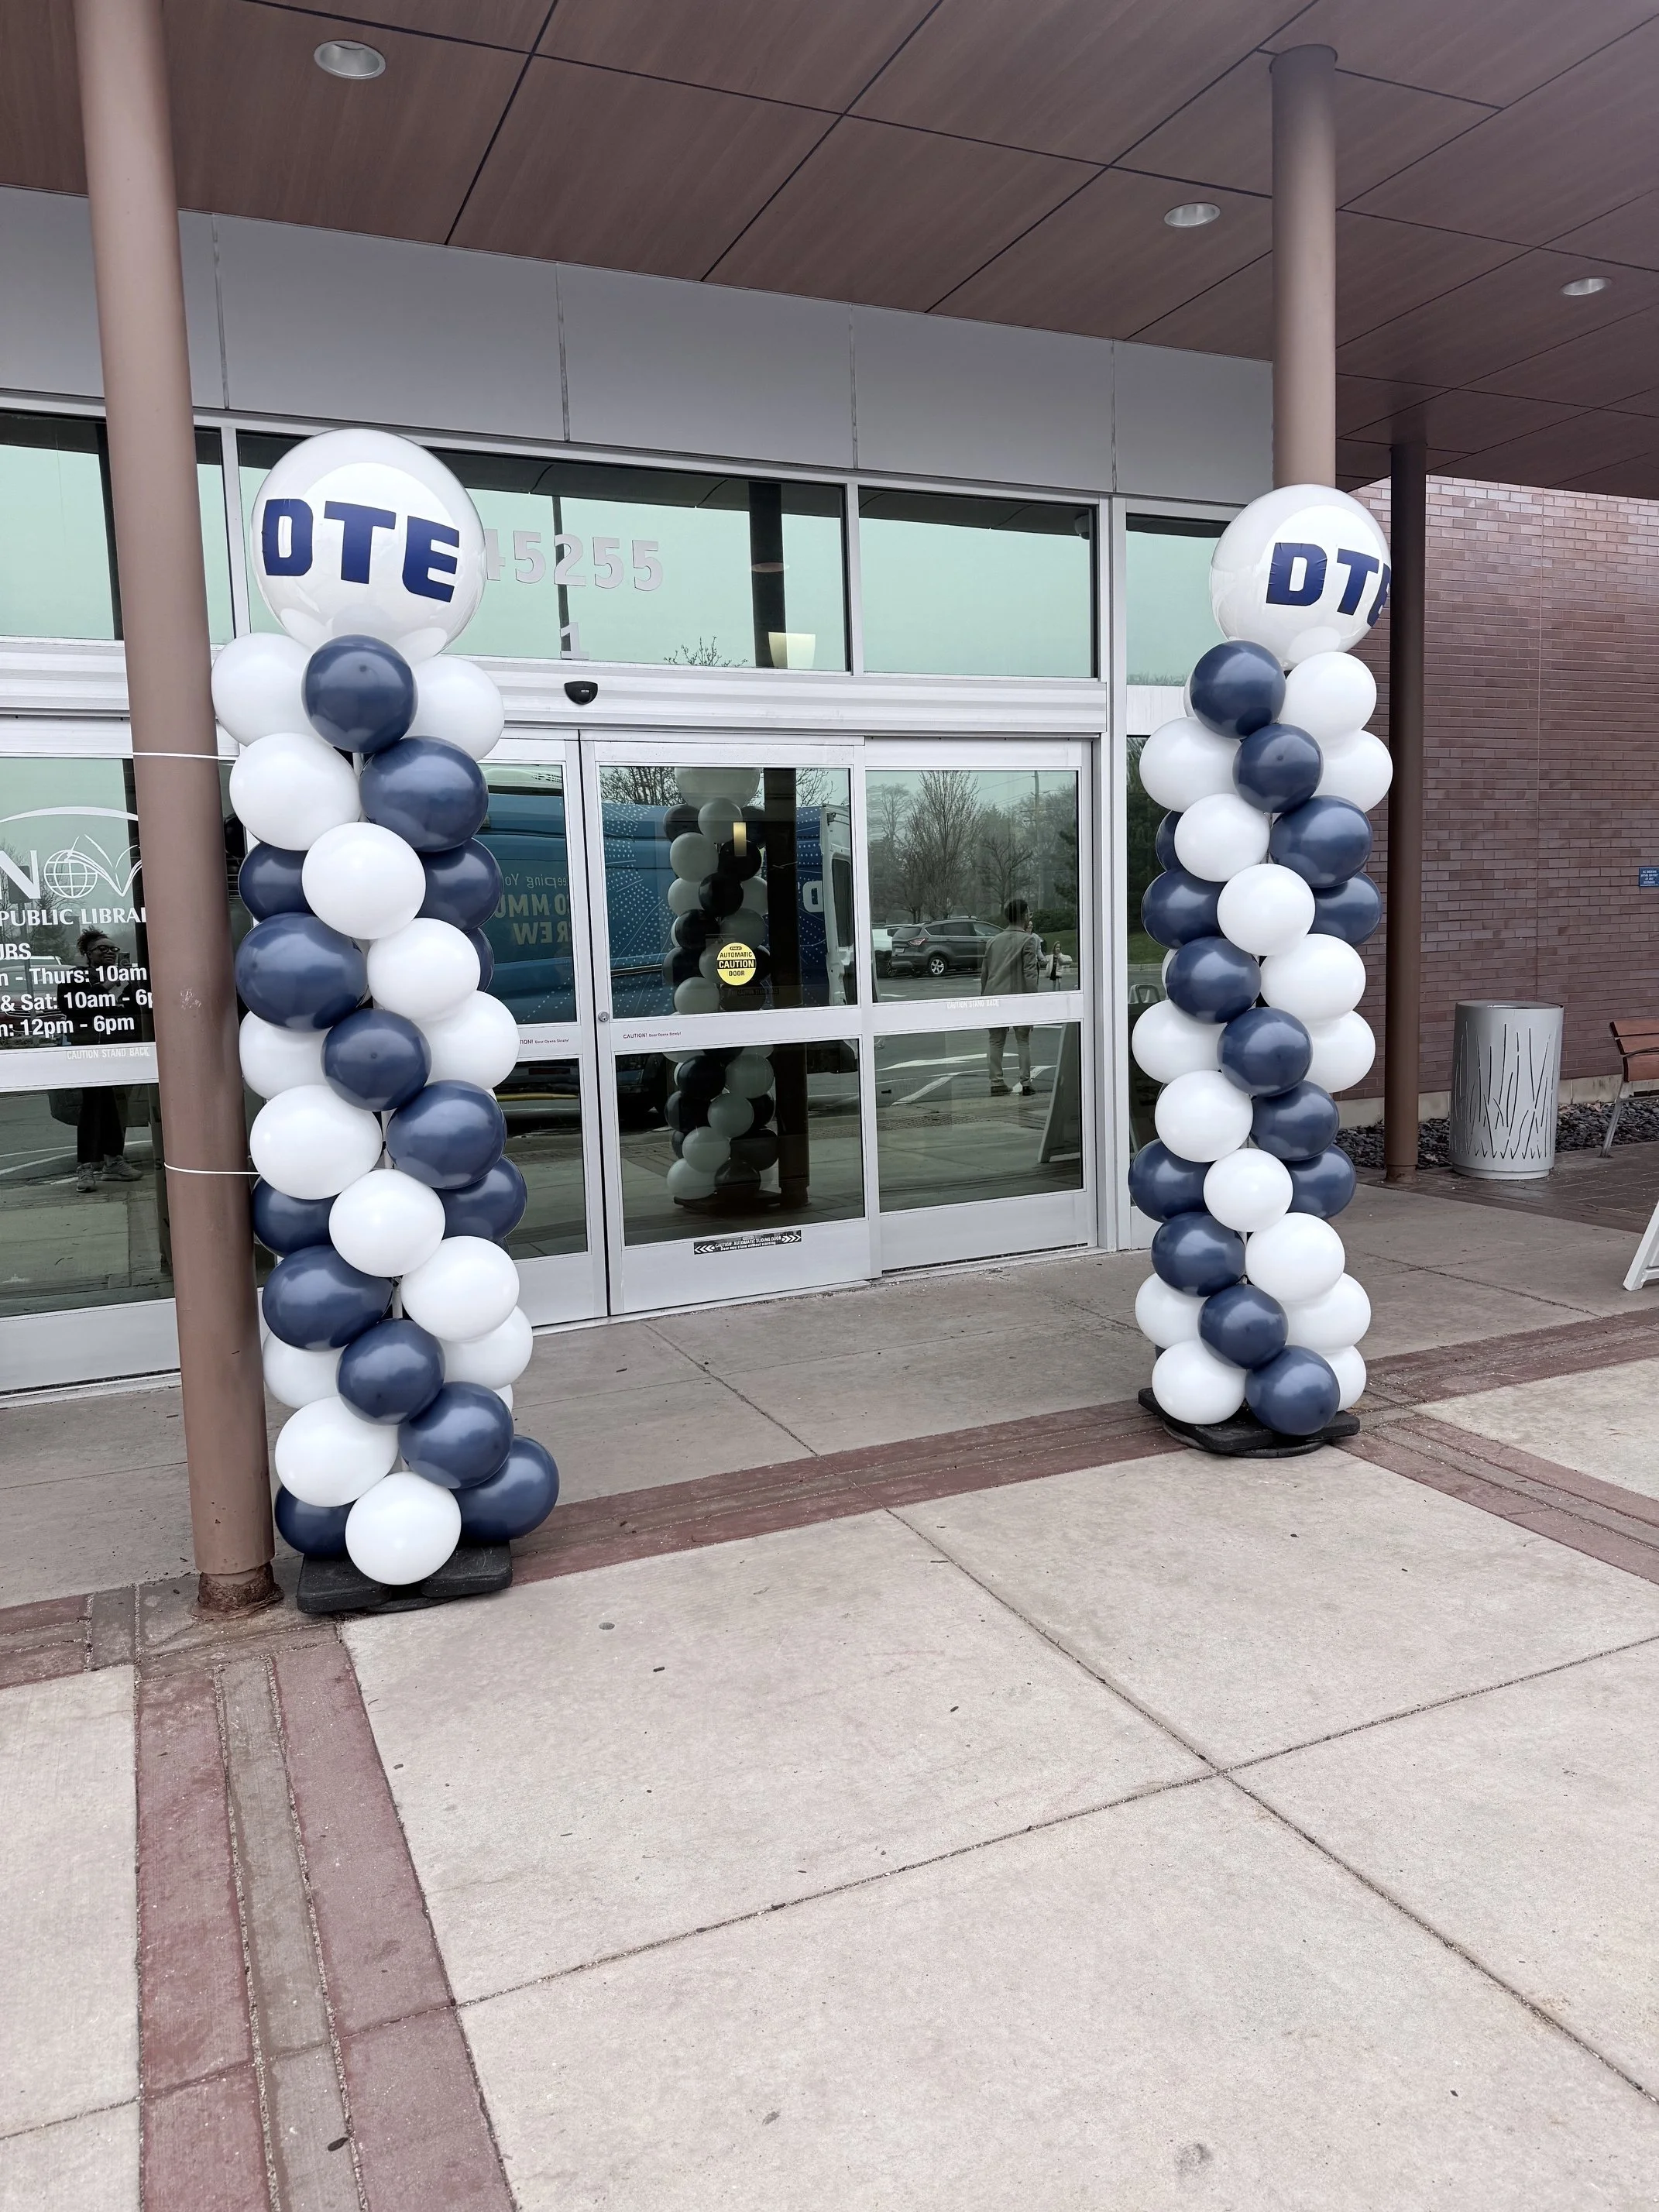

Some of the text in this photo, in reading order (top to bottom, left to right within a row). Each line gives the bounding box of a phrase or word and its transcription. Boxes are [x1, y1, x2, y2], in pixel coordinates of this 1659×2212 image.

[261, 498, 460, 603] DTE
[560, 621, 589, 660] 1
[0, 908, 74, 927] PUBLIC
[719, 960, 754, 969] CAUTION
[29, 966, 90, 985] Thurs:
[95, 965, 147, 983] 10am
[0, 994, 15, 1012] &
[20, 993, 58, 1011] Sat:
[64, 991, 116, 1009] 10am
[20, 1018, 74, 1039] 12pm
[93, 1015, 135, 1035] 6pm
[67, 1046, 150, 1060] CAUTION STAND BACK
